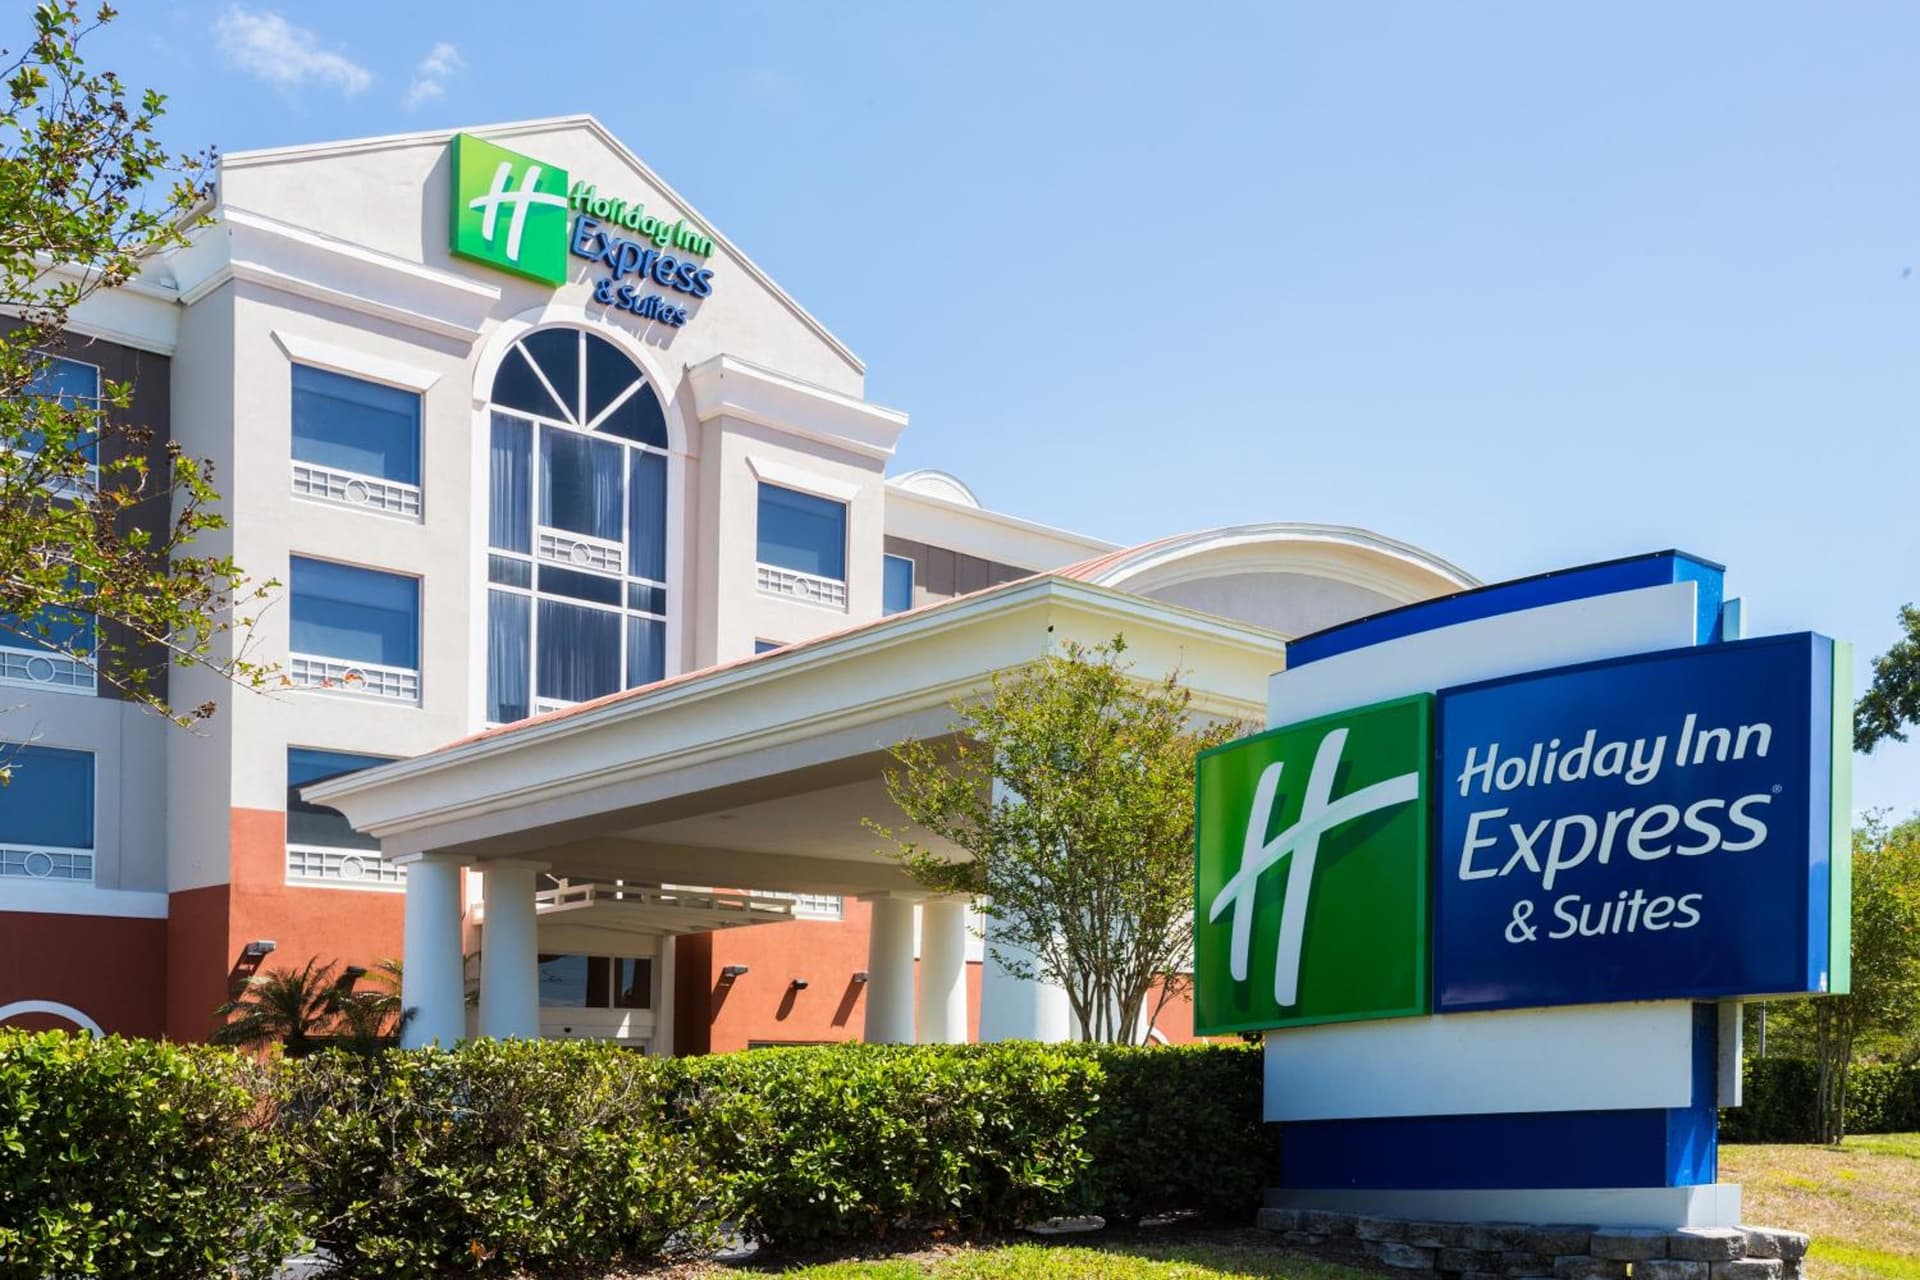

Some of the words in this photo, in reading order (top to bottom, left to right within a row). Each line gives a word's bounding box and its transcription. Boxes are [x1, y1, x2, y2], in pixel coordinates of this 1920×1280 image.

[569, 181, 674, 247] Holiday
[672, 220, 715, 257] Inn
[570, 214, 714, 298] Express
[595, 279, 615, 304] &
[618, 284, 687, 328] Suites
[1457, 729, 1667, 796] Holiday
[1675, 713, 1772, 767] Inn
[1458, 794, 1772, 890] Express
[1504, 899, 1537, 943] &
[1549, 889, 1702, 939] Suites
